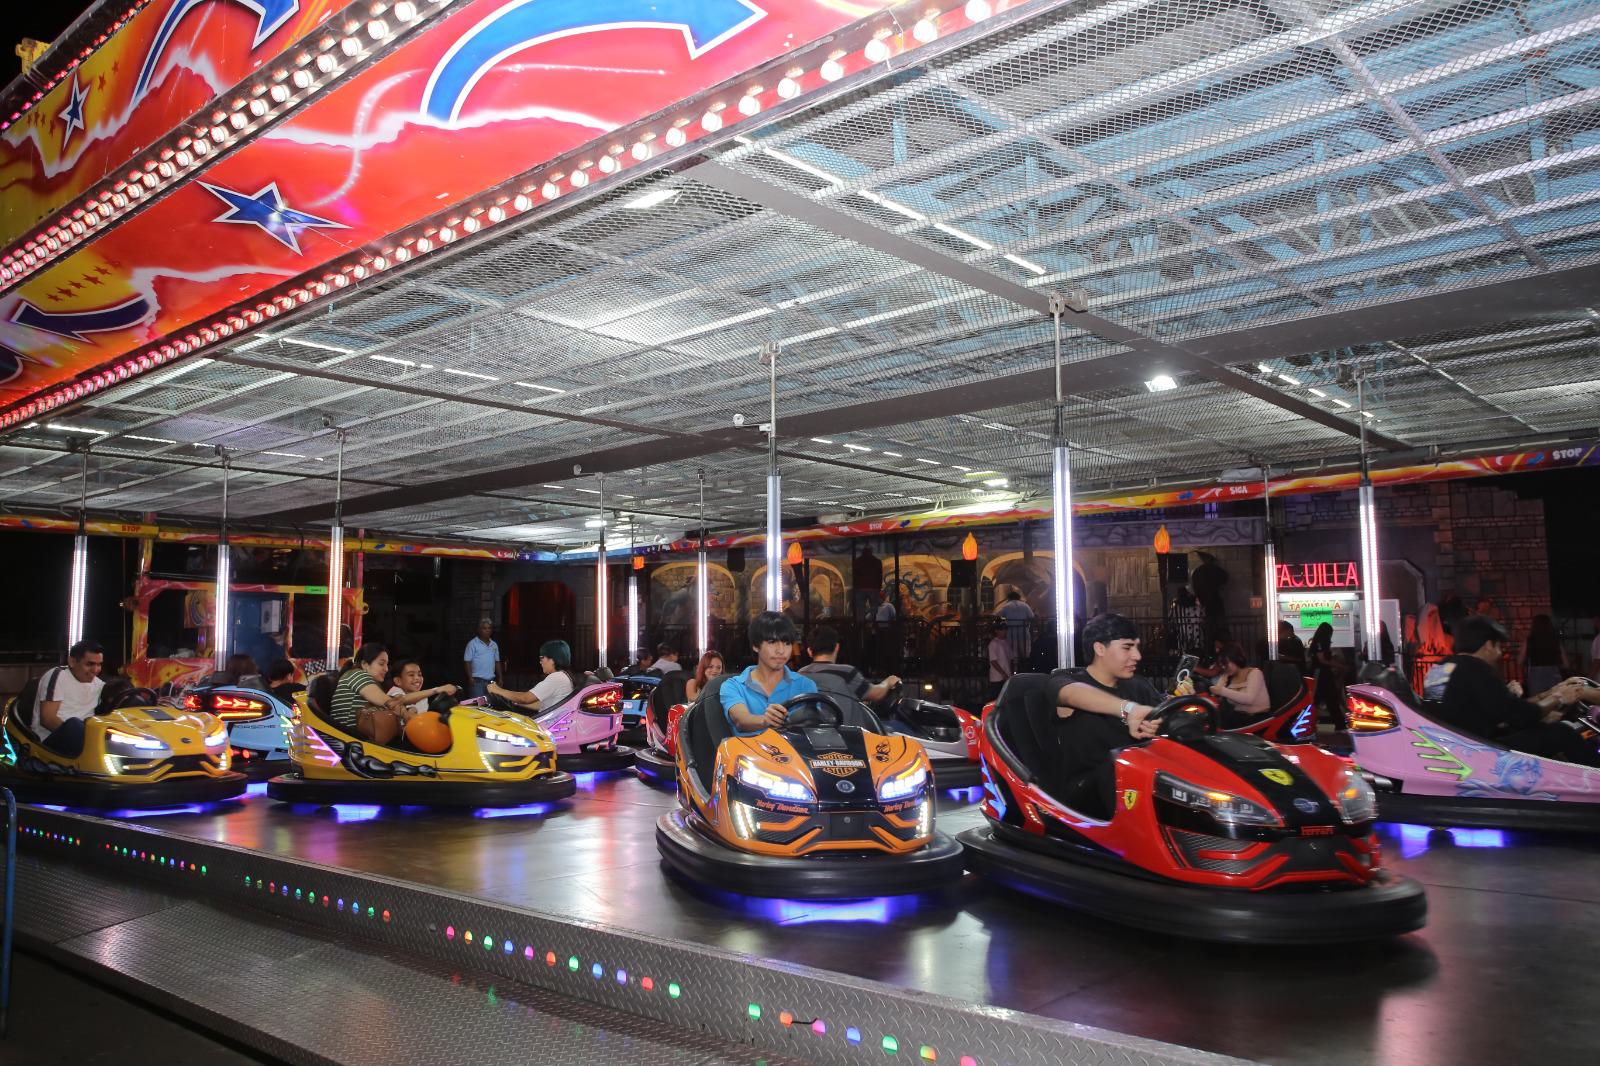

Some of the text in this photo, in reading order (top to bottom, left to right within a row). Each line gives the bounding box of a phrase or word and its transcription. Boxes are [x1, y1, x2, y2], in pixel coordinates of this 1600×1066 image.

[1552, 447, 1582, 460] STOP
[1229, 485, 1248, 495] SIGA
[121, 524, 141, 533] STOP
